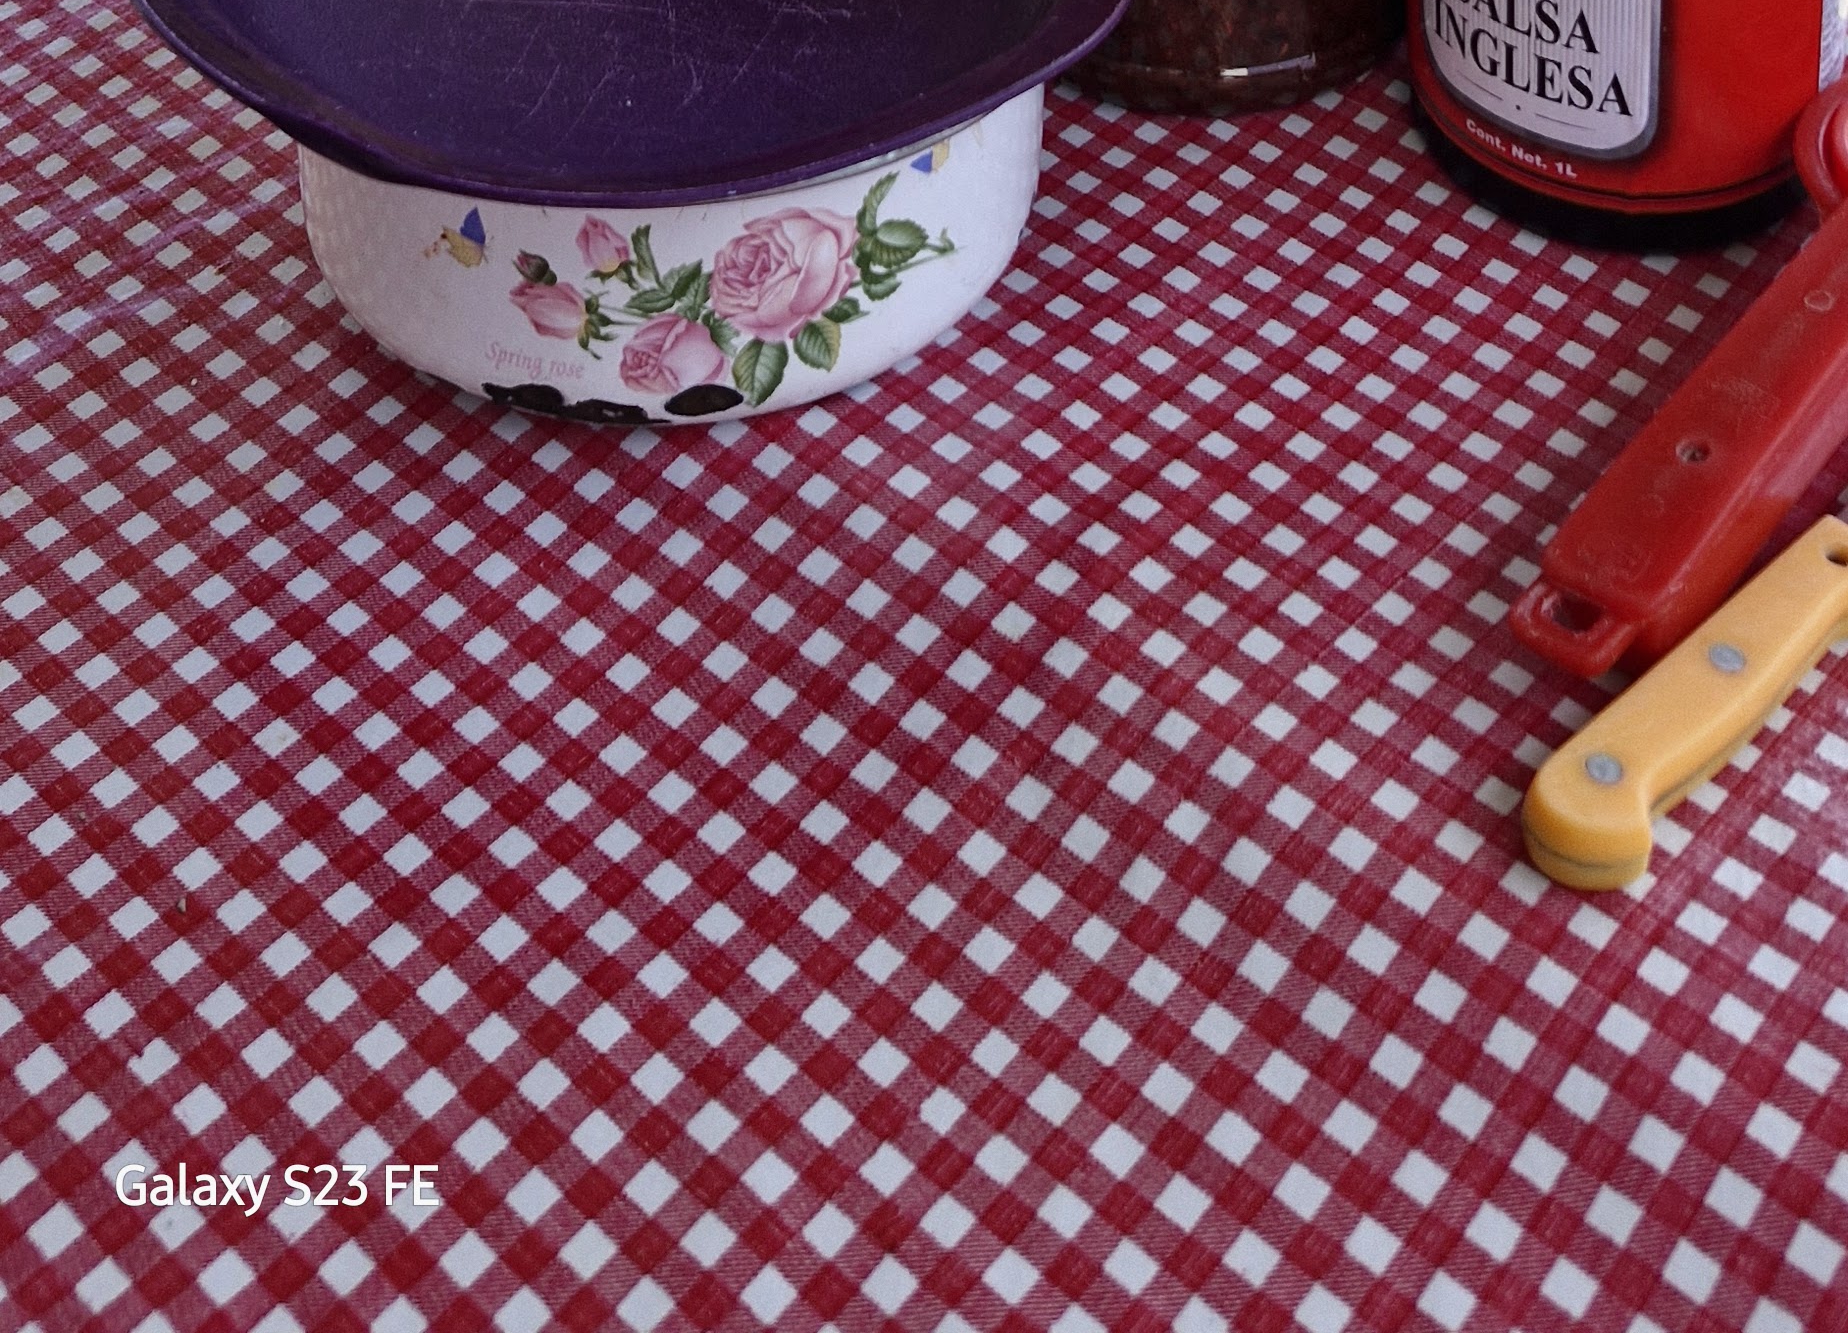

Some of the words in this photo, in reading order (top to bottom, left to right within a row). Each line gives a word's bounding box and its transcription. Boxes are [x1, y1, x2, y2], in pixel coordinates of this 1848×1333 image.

[1466, 118, 1506, 152] Cont.
[1512, 144, 1547, 170] Net.
[1555, 161, 1577, 179] 1L
[485, 341, 542, 380] Spring
[548, 360, 584, 379] rose
